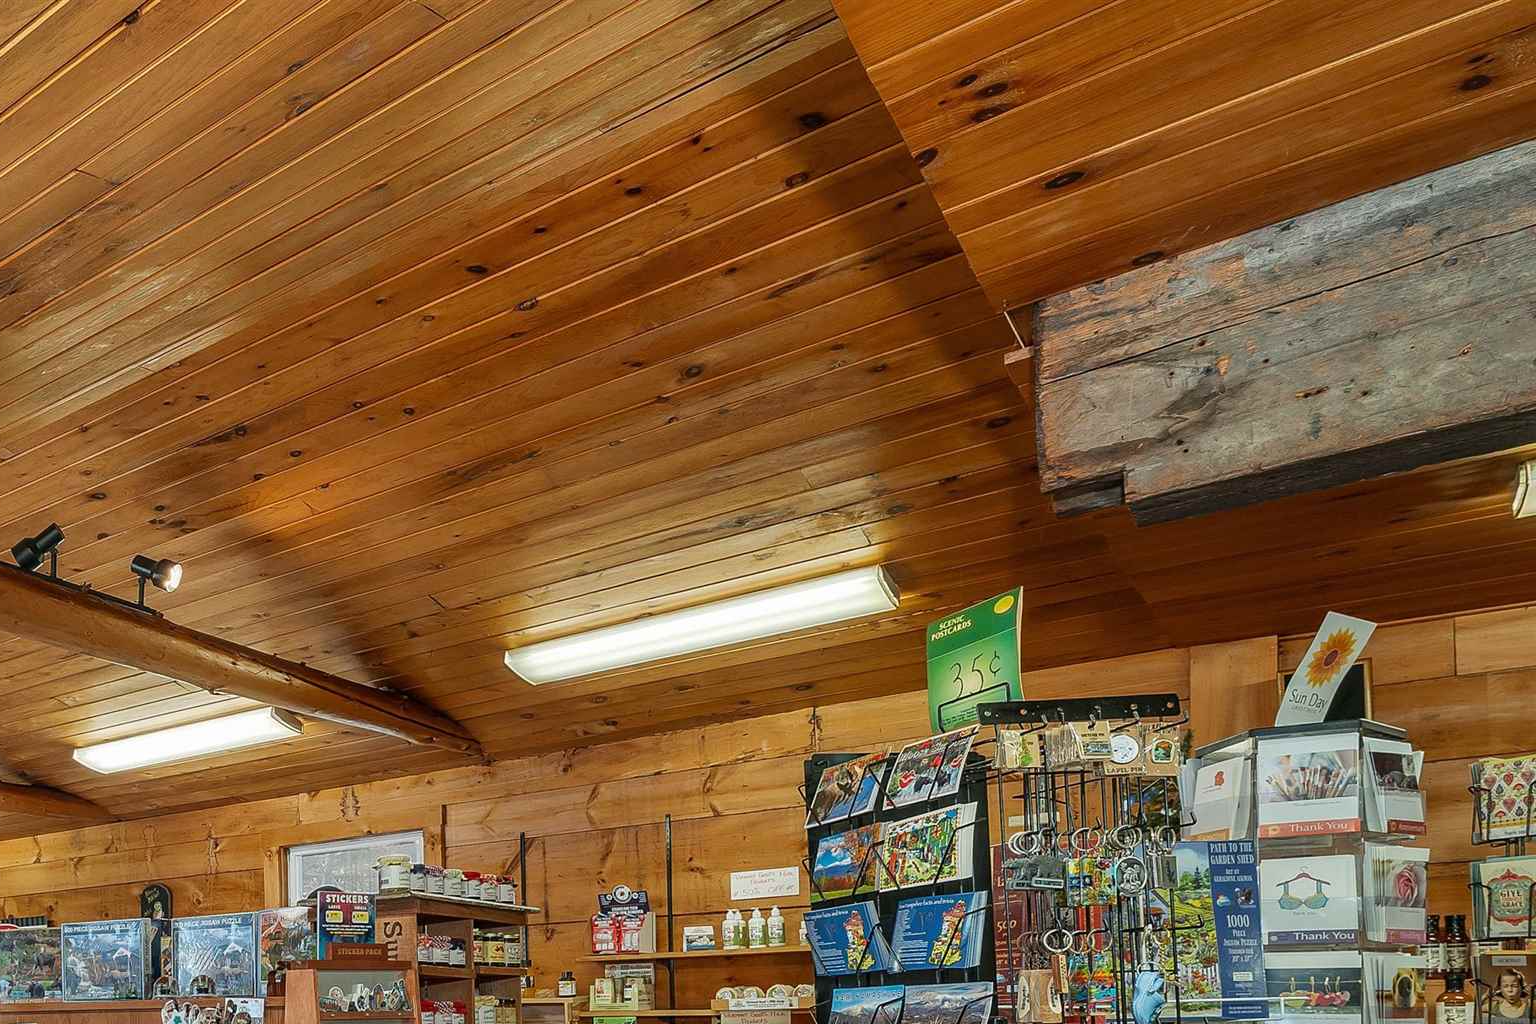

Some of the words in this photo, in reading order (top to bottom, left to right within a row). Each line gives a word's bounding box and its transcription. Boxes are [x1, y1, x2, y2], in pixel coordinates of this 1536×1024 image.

[939, 615, 965, 630] SCENIC
[931, 620, 972, 641] POSTCARDS
[1289, 689, 1308, 705] Sun
[1309, 693, 1328, 709] Day
[1288, 823, 1324, 833] Thank
[1326, 821, 1348, 831] You
[1209, 842, 1227, 853] PATH
[1228, 842, 1237, 852] TO
[1239, 841, 1253, 852] THE
[1210, 854, 1235, 865] GARDEN
[1236, 854, 1255, 864] SHED
[325, 894, 369, 904] STICKERS
[1226, 914, 1250, 928] 1000
[1295, 931, 1329, 941] Thank
[1332, 931, 1355, 941] You
